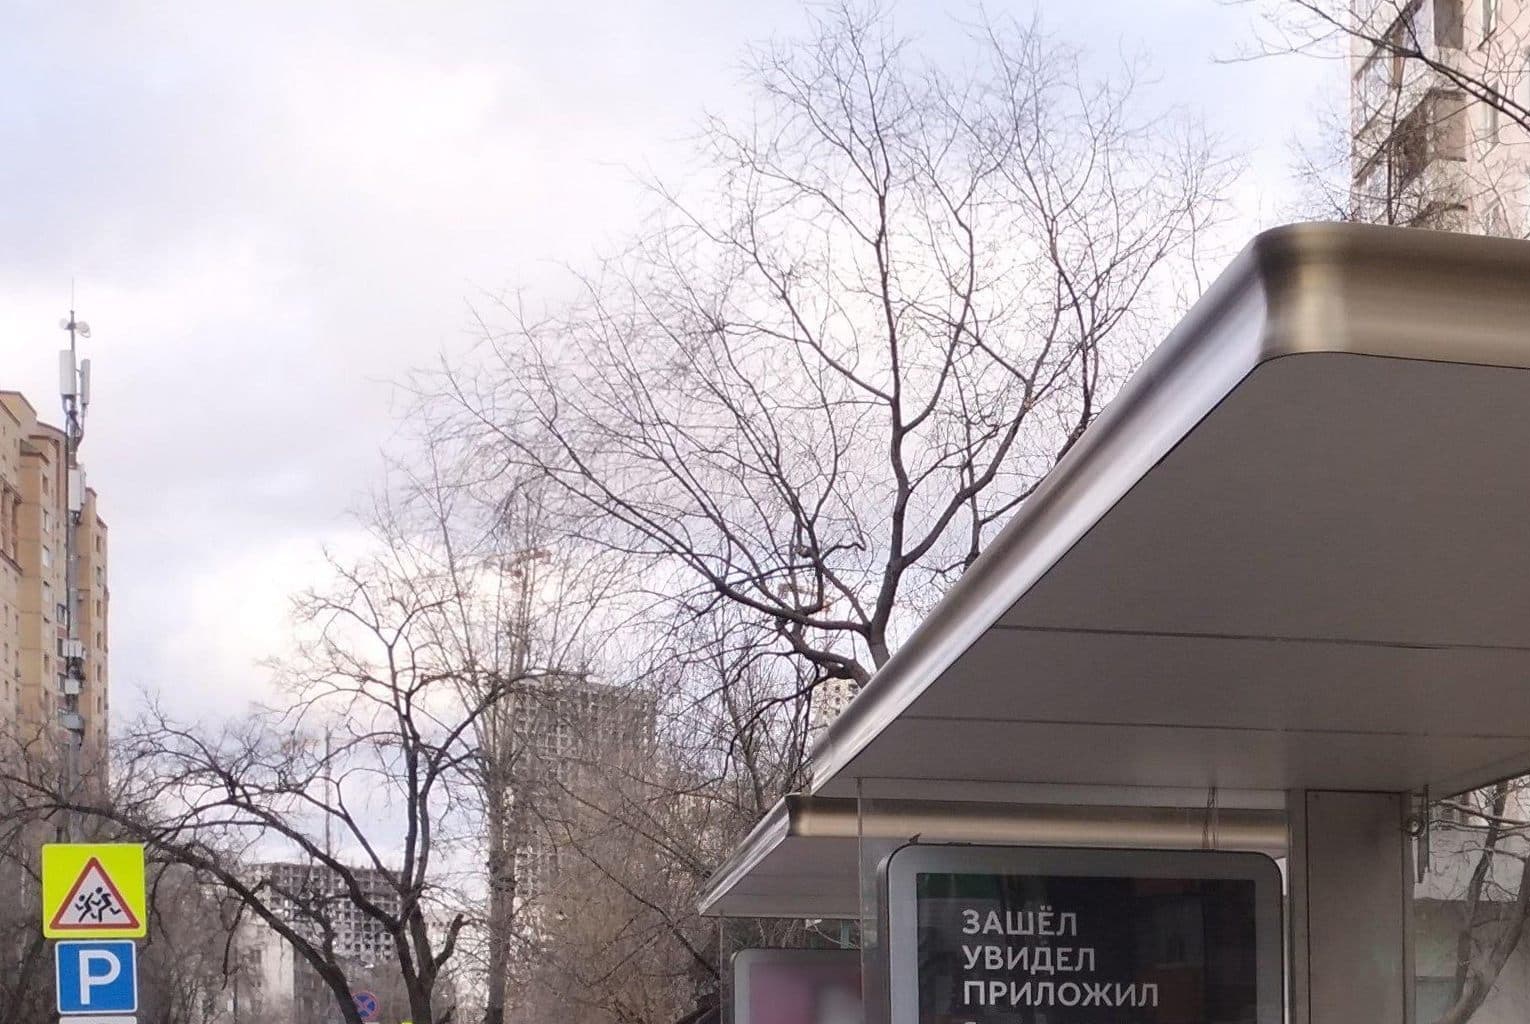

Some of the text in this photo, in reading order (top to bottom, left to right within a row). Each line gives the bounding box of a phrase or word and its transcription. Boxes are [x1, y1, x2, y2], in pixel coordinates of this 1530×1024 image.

[962, 905, 1077, 936] ЗАШЁЛ
[962, 945, 1095, 975] УВИДЕЛ
[79, 949, 121, 1005] P
[963, 980, 1159, 1007] ПРИЛОЖИЛ
